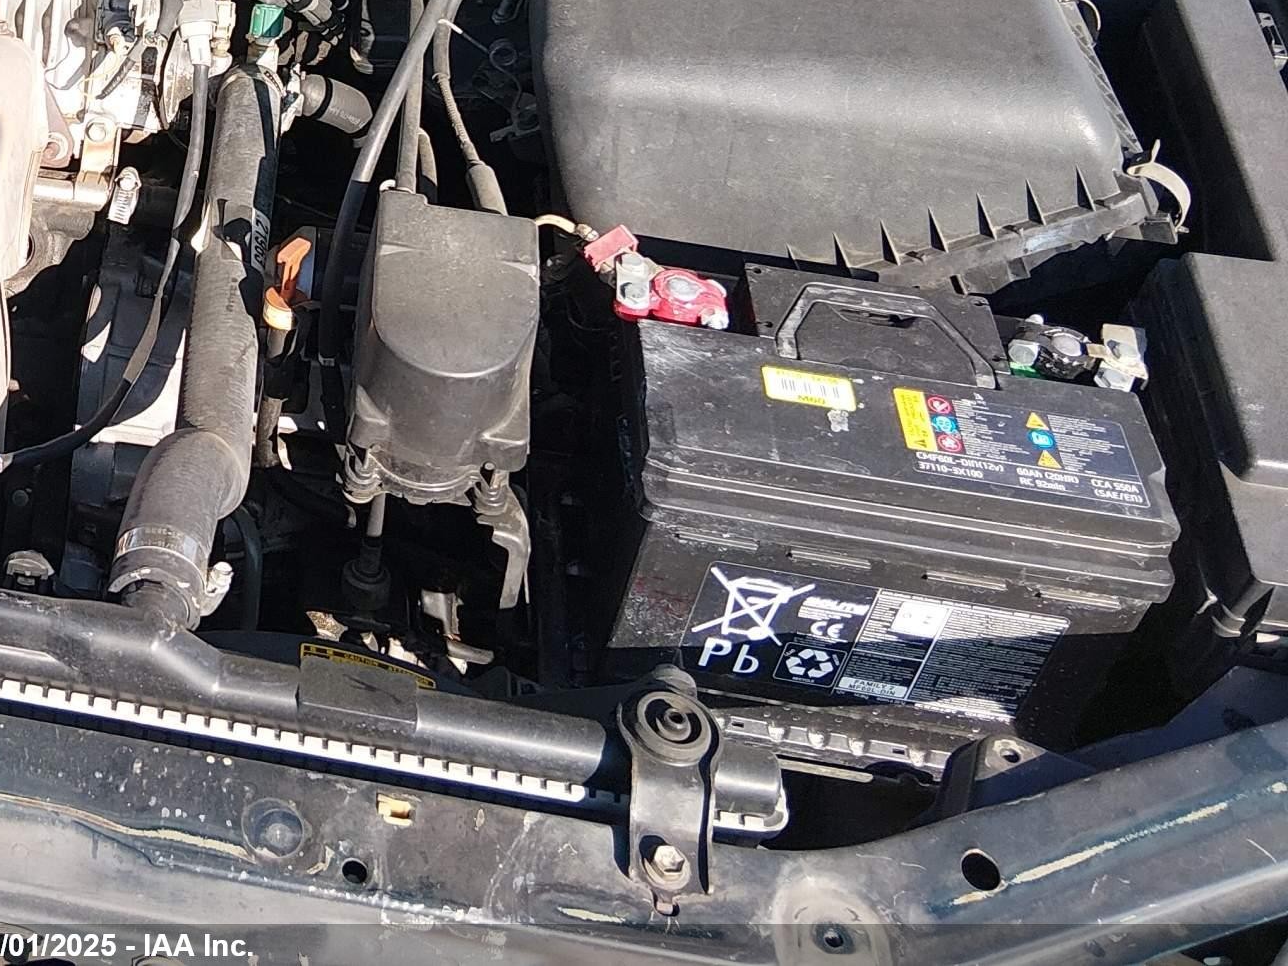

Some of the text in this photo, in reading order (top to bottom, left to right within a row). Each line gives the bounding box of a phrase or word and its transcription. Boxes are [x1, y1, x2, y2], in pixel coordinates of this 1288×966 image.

[1019, 476, 1035, 487] RC
[1091, 478, 1113, 489] CCA
[698, 636, 759, 674] Pb
